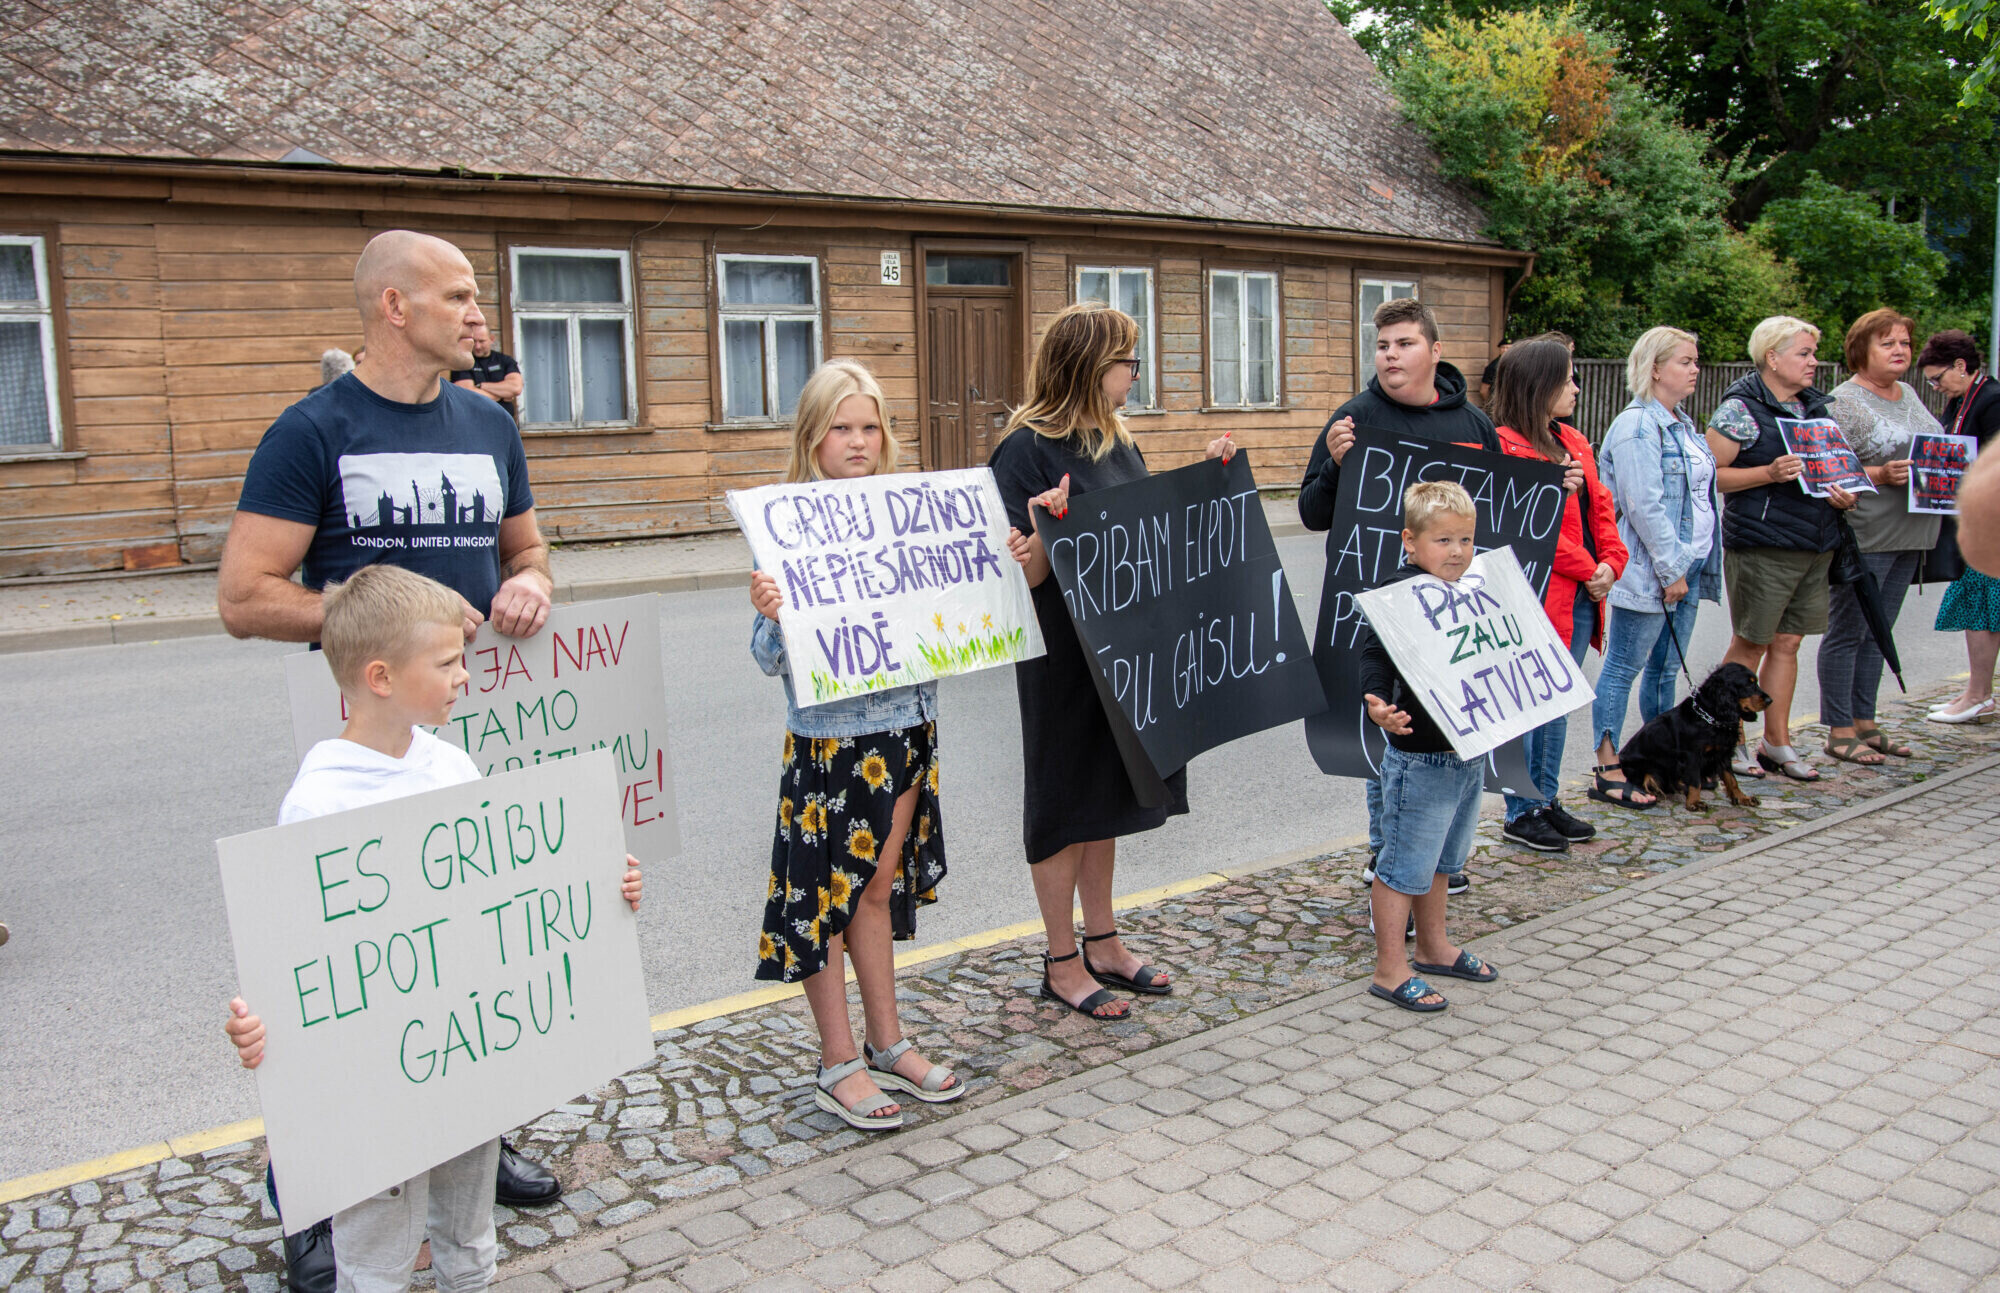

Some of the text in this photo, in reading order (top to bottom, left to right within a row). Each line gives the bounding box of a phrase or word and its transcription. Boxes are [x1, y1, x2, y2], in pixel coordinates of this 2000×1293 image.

[883, 265, 899, 281] 45
[1793, 425, 1843, 442] PIKETS
[1923, 440, 1966, 458] PIKETS
[1807, 456, 1849, 475] PRET
[1929, 476, 1959, 492] PRET
[351, 535, 495, 549] LONDON, UNITED KINGDOM
[1186, 489, 1258, 583] ELPOT
[1411, 574, 1501, 631] PAR
[552, 620, 630, 679] NAV
[815, 611, 901, 679] VIDĒ
[1174, 568, 1287, 709] GAISU!
[1446, 613, 1524, 665] ZALU
[1429, 643, 1574, 737] LATVIJU
[315, 797, 565, 923] ES GRIBU
[294, 880, 592, 1028] ELPOT TĪRU
[400, 951, 576, 1084] GAISU!
